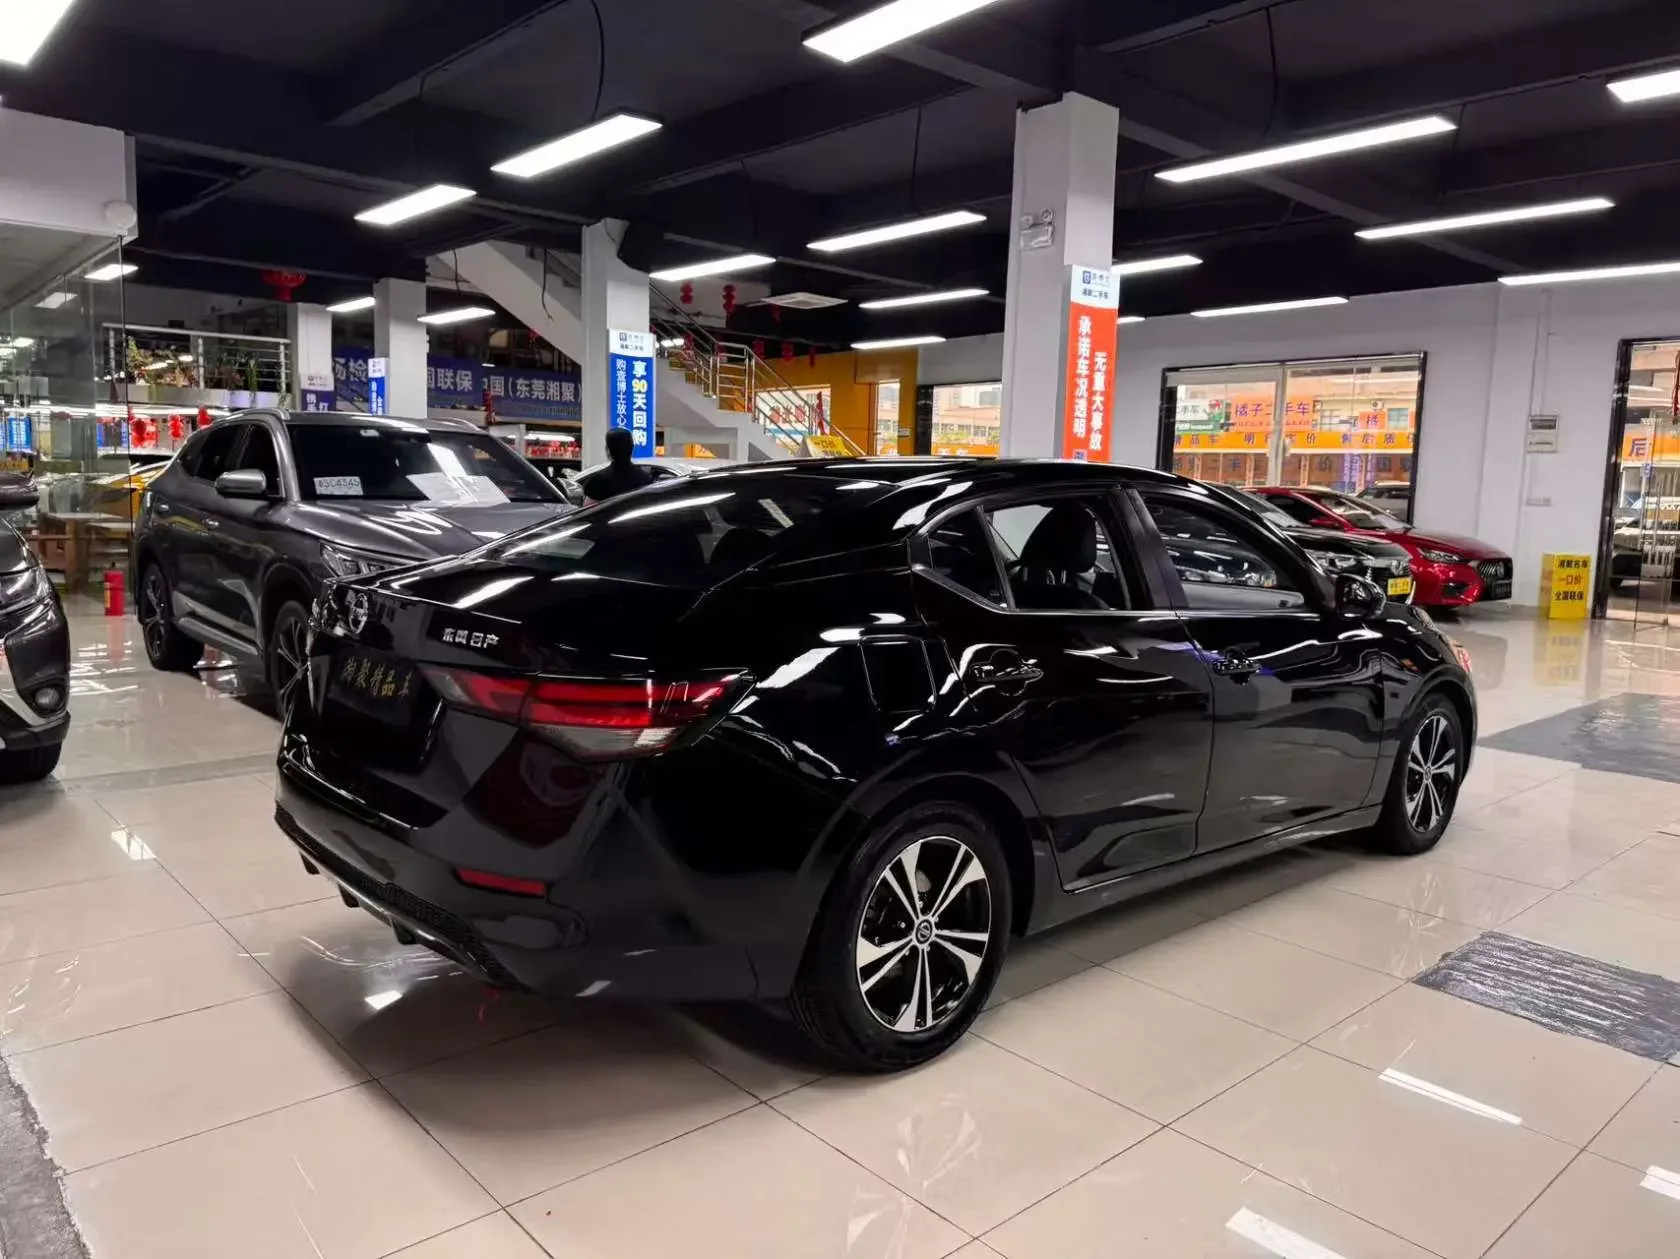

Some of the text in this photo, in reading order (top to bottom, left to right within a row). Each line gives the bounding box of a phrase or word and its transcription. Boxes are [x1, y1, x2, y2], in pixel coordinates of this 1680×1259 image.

[615, 358, 627, 429] 购查博士放心
[632, 361, 648, 447] 享90天回购
[442, 627, 500, 648] 东风日产
